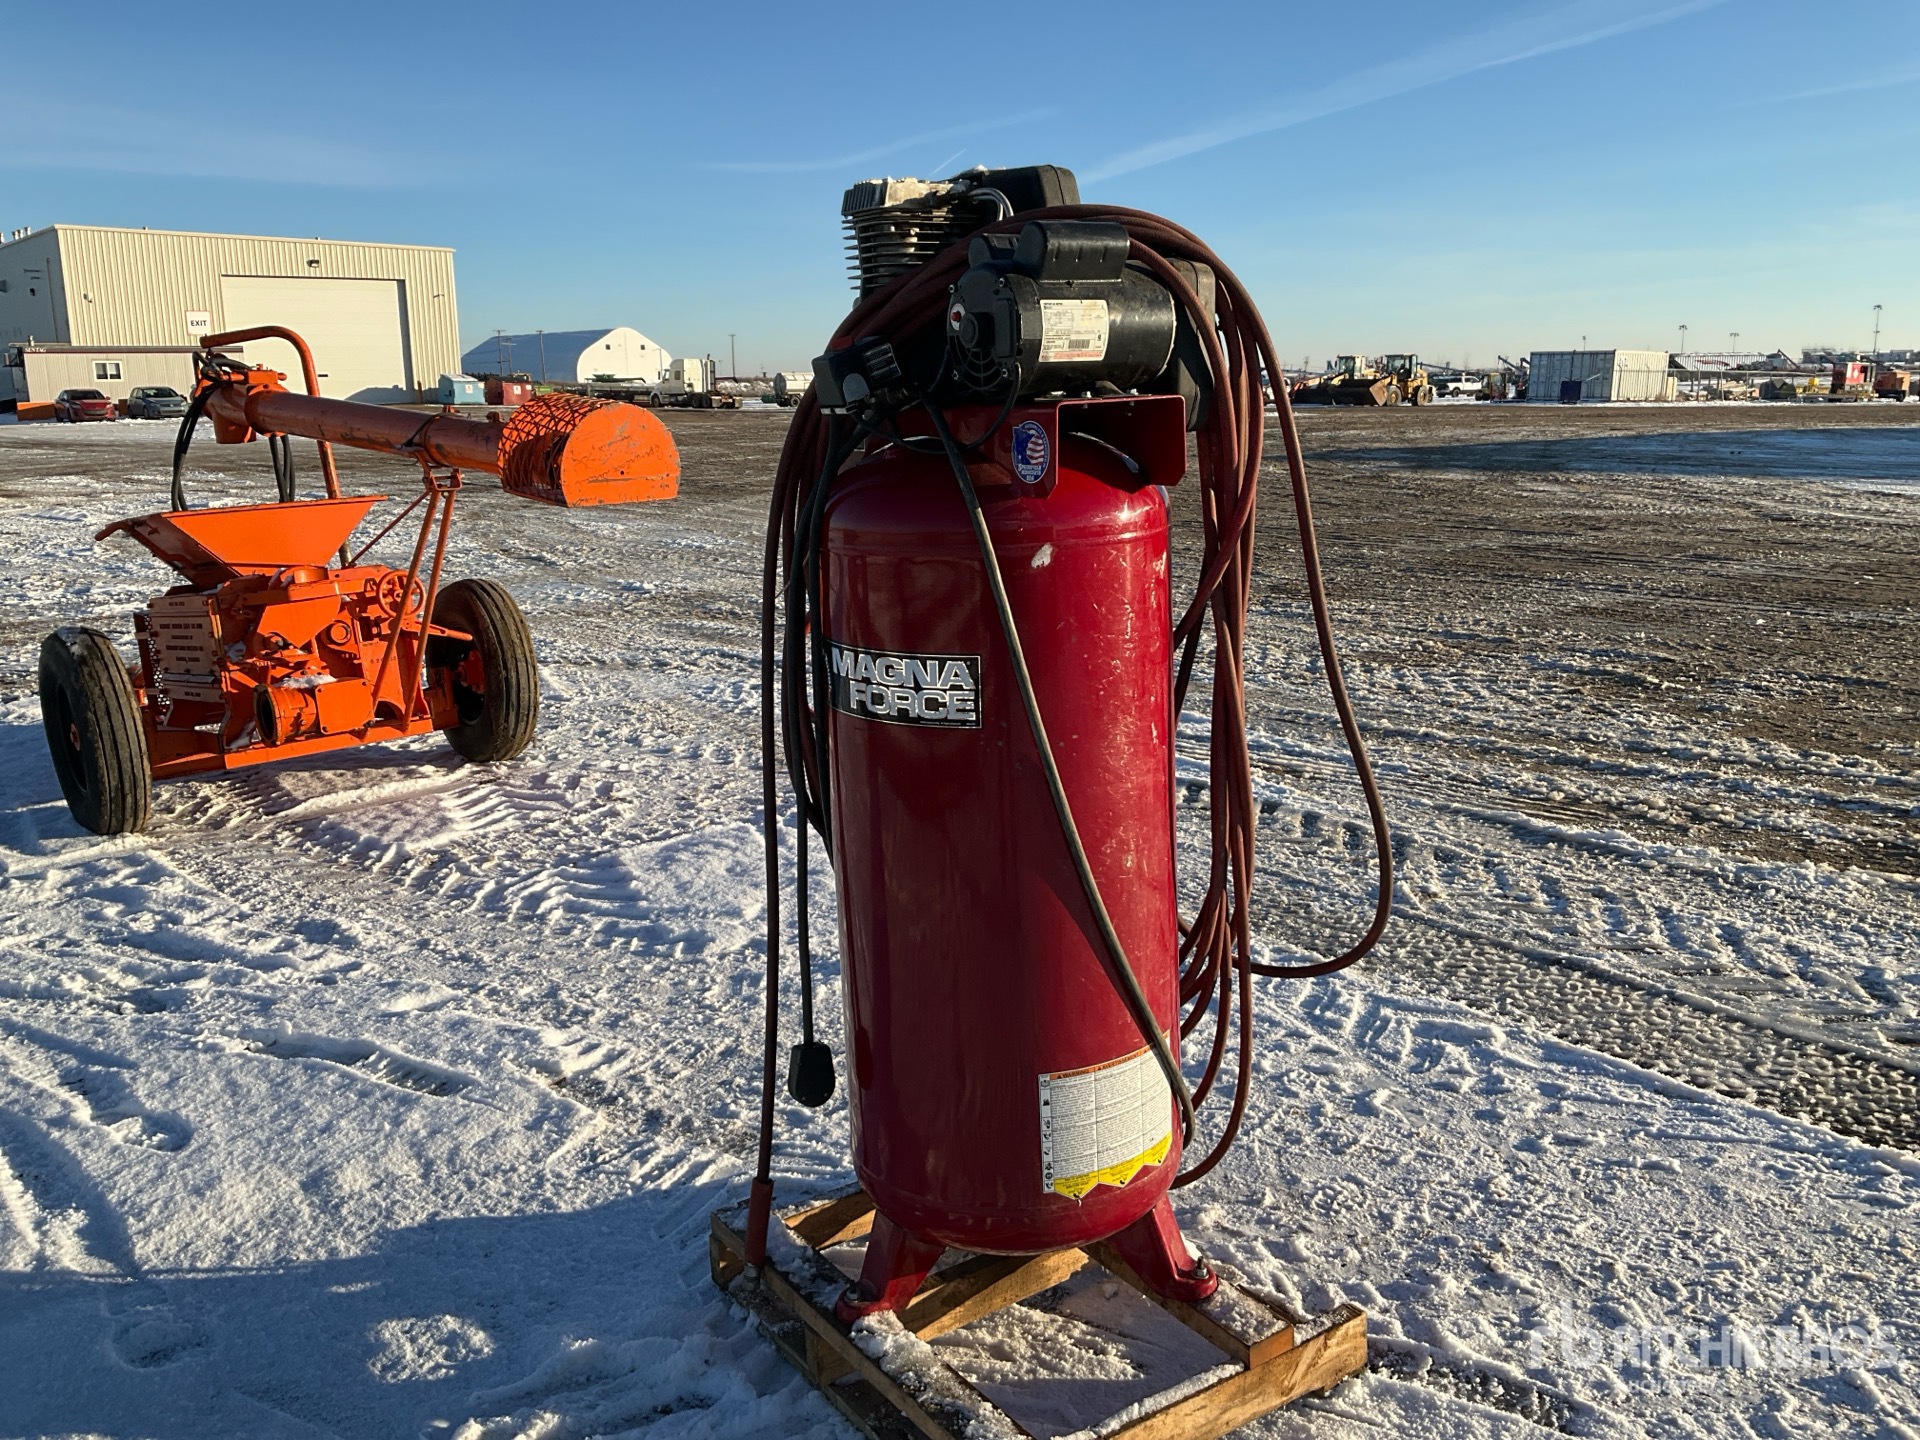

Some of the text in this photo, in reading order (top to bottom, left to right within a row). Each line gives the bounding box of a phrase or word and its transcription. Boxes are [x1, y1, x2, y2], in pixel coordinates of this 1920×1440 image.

[190, 319, 207, 327] EXIT
[831, 646, 976, 690] MAGNA
[849, 680, 976, 721] FORCE
[1062, 1069, 1089, 1078] WARNING
